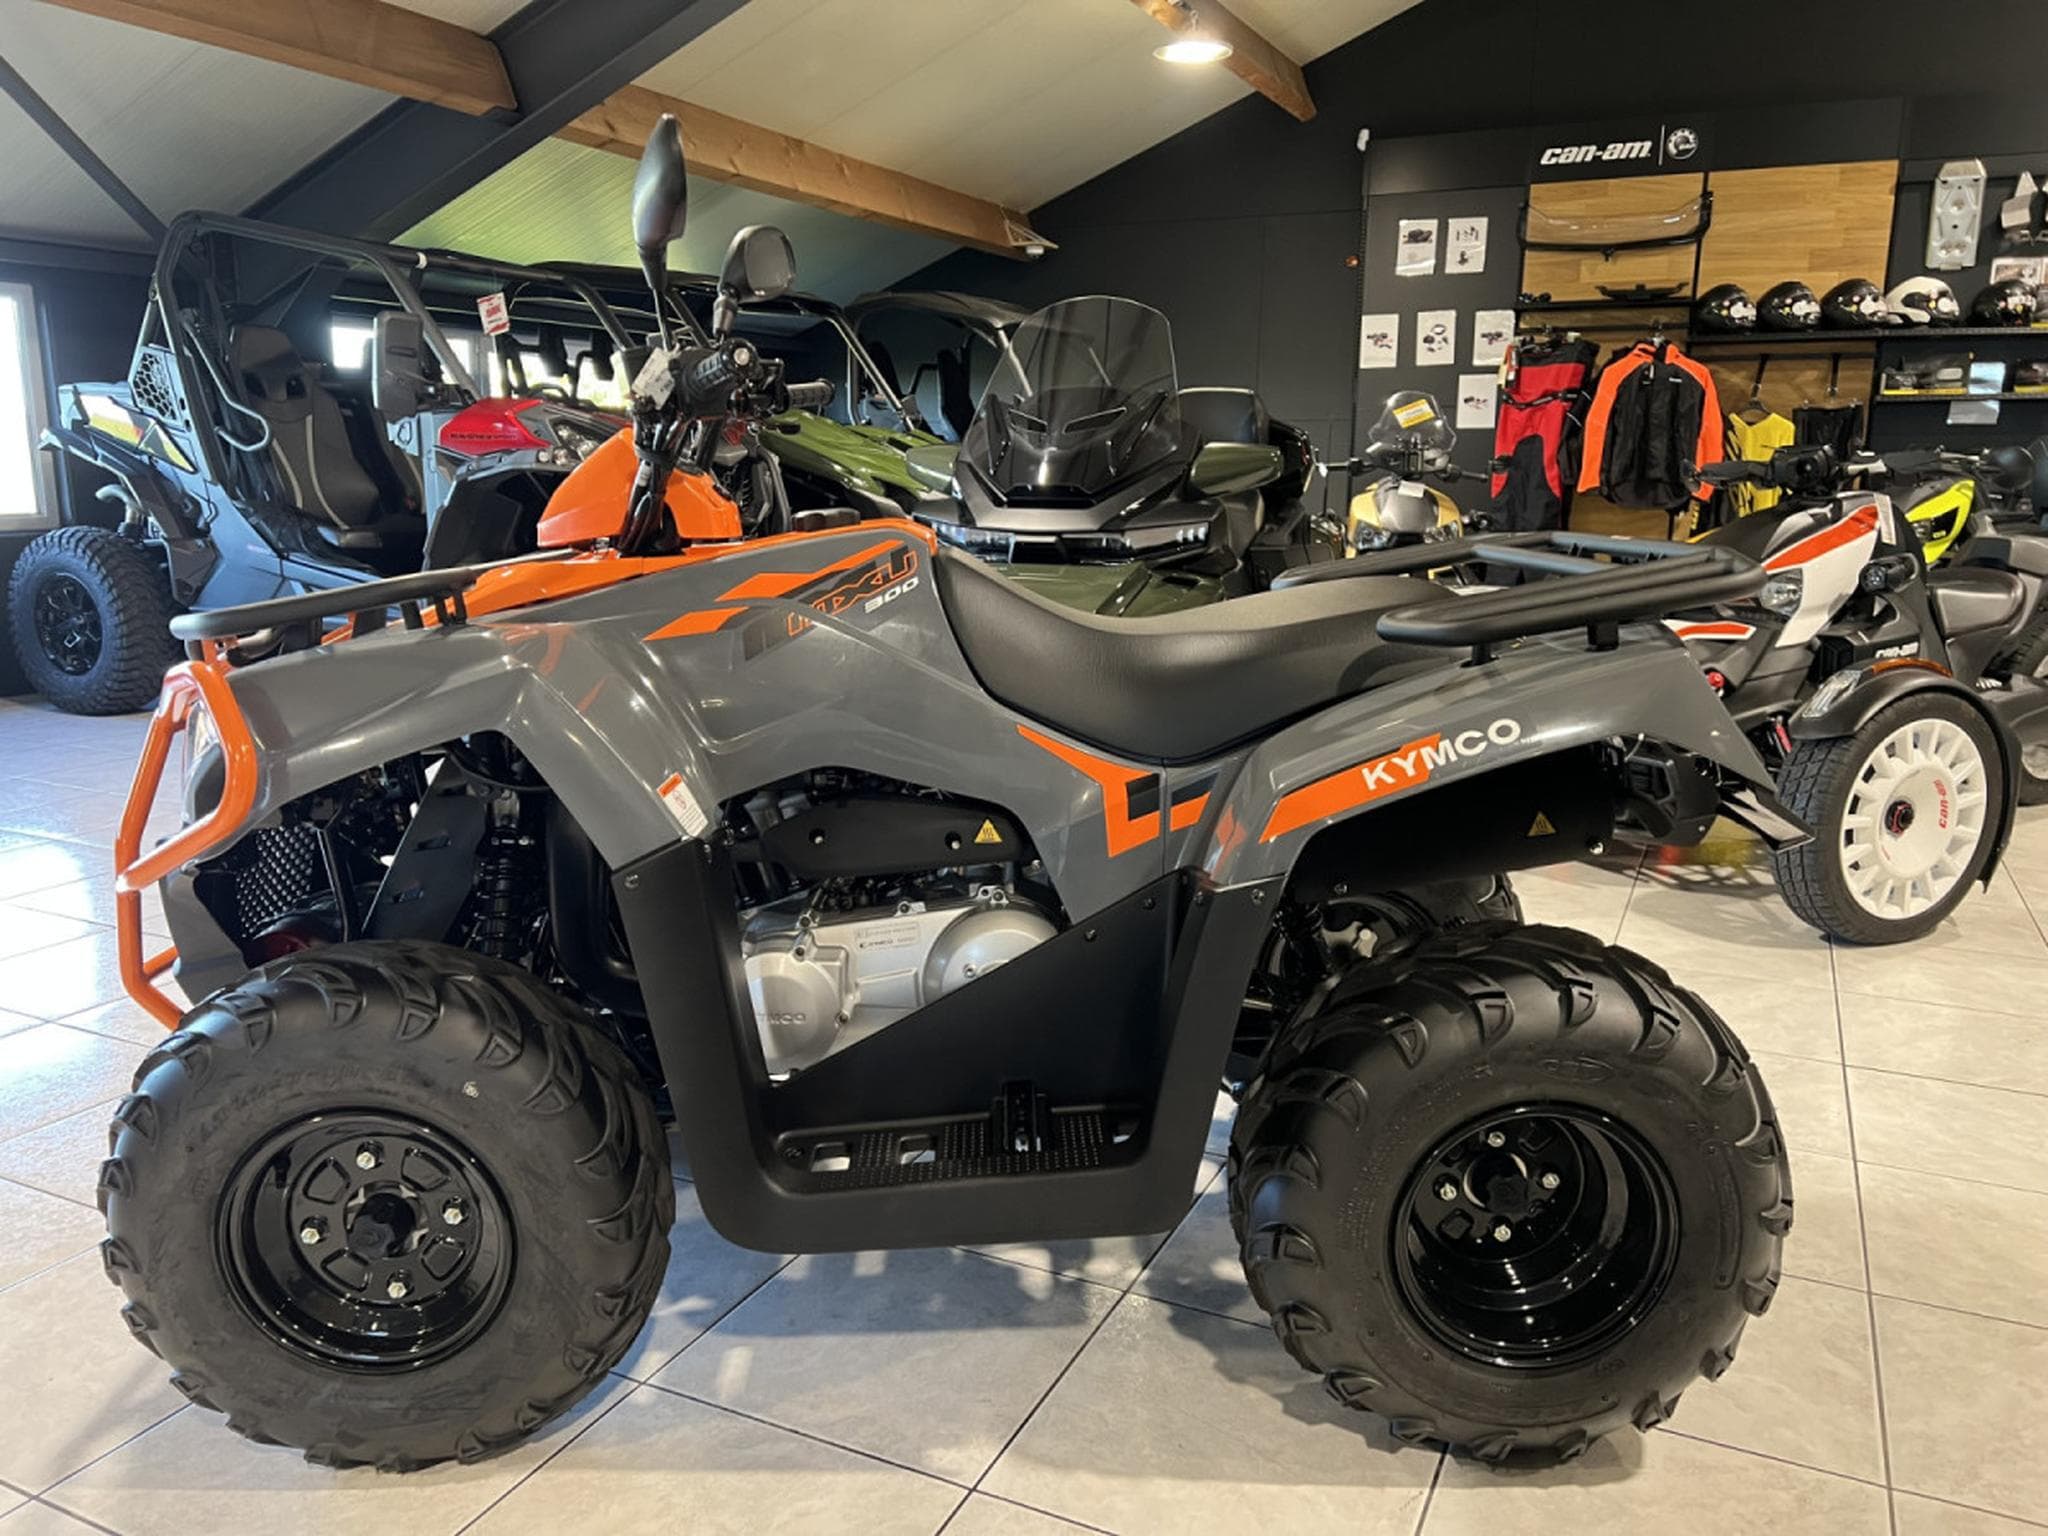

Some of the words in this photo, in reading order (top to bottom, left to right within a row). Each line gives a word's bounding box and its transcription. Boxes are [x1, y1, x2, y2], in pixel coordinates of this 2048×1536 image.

[1540, 140, 1652, 165] can-am
[864, 576, 919, 614] 300
[1361, 718, 1521, 791] KYMCO
